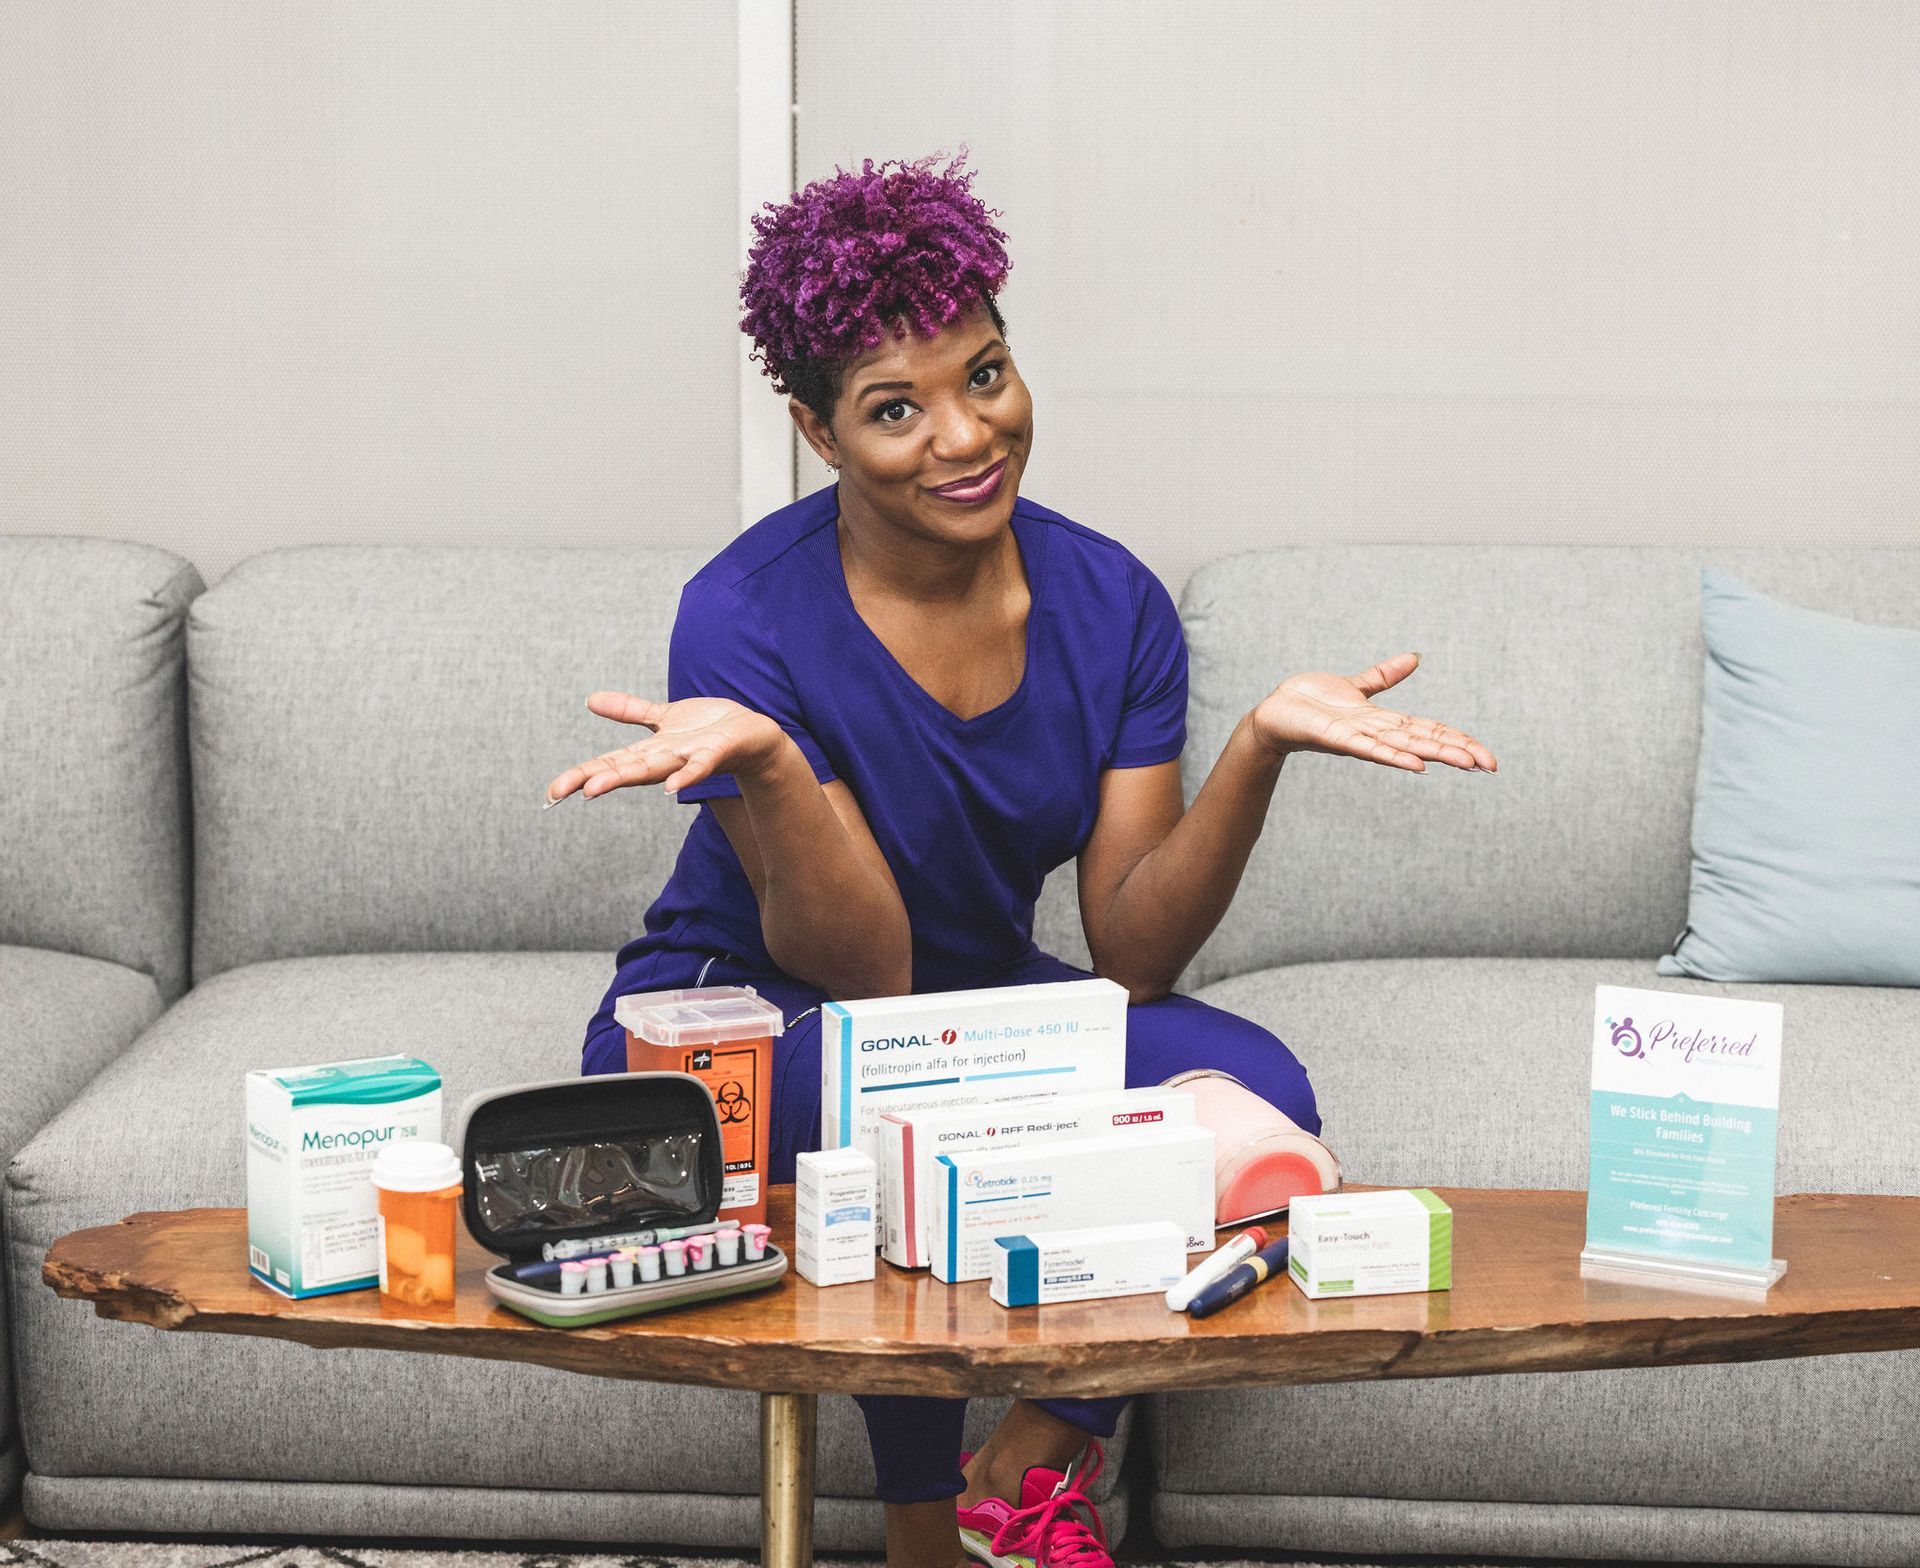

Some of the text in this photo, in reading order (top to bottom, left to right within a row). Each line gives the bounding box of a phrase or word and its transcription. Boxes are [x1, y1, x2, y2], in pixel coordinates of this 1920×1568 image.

[964, 1026, 1033, 1042] Multi-Dose
[1037, 1023, 1062, 1035] 450
[1066, 1021, 1079, 1033] IU
[1649, 1019, 1757, 1063] Preferred
[861, 1049, 1026, 1079] (follitropin alfa for injection)
[860, 1095, 978, 1116] For subcutaneous injection
[1001, 1125, 1024, 1136] RFF
[1027, 1120, 1079, 1133] Redi-ject
[1113, 1115, 1130, 1125] 900
[1611, 1104, 1753, 1134] We Stick Behind Building
[302, 1126, 396, 1151] Menopur
[1656, 1126, 1704, 1144] Families
[976, 1176, 1017, 1189] Cetrotide
